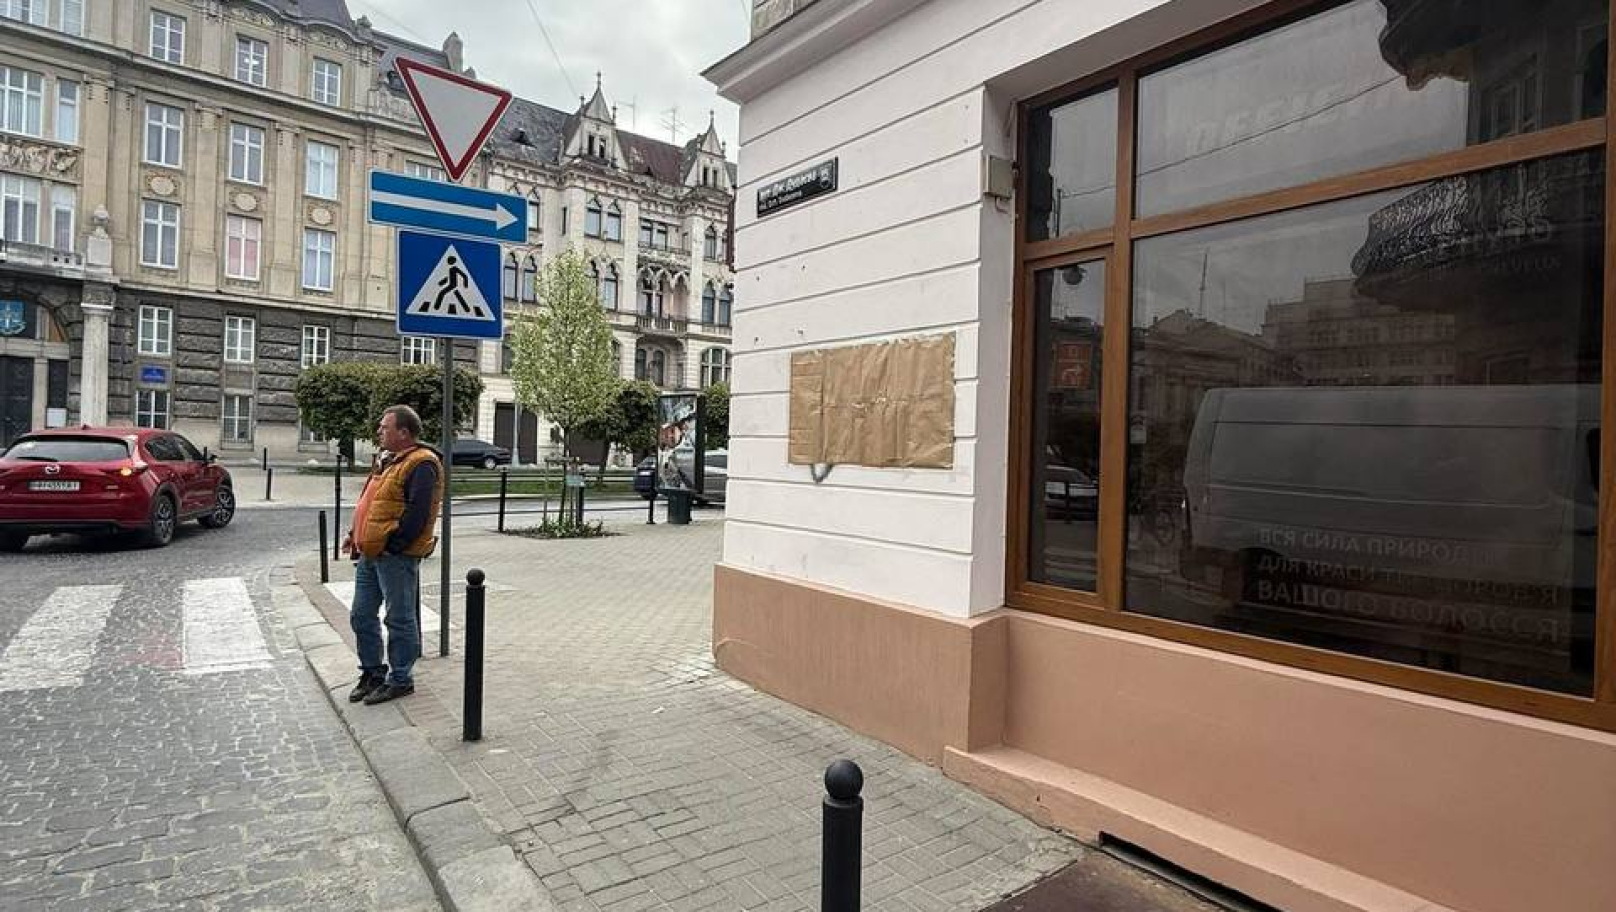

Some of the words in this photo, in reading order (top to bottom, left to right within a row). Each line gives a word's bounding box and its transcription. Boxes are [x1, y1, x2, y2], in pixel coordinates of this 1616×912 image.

[1259, 528, 1296, 547] ВСЯ
[1302, 531, 1360, 553] СИЛА
[1258, 580, 1378, 615] ВАШОГО
